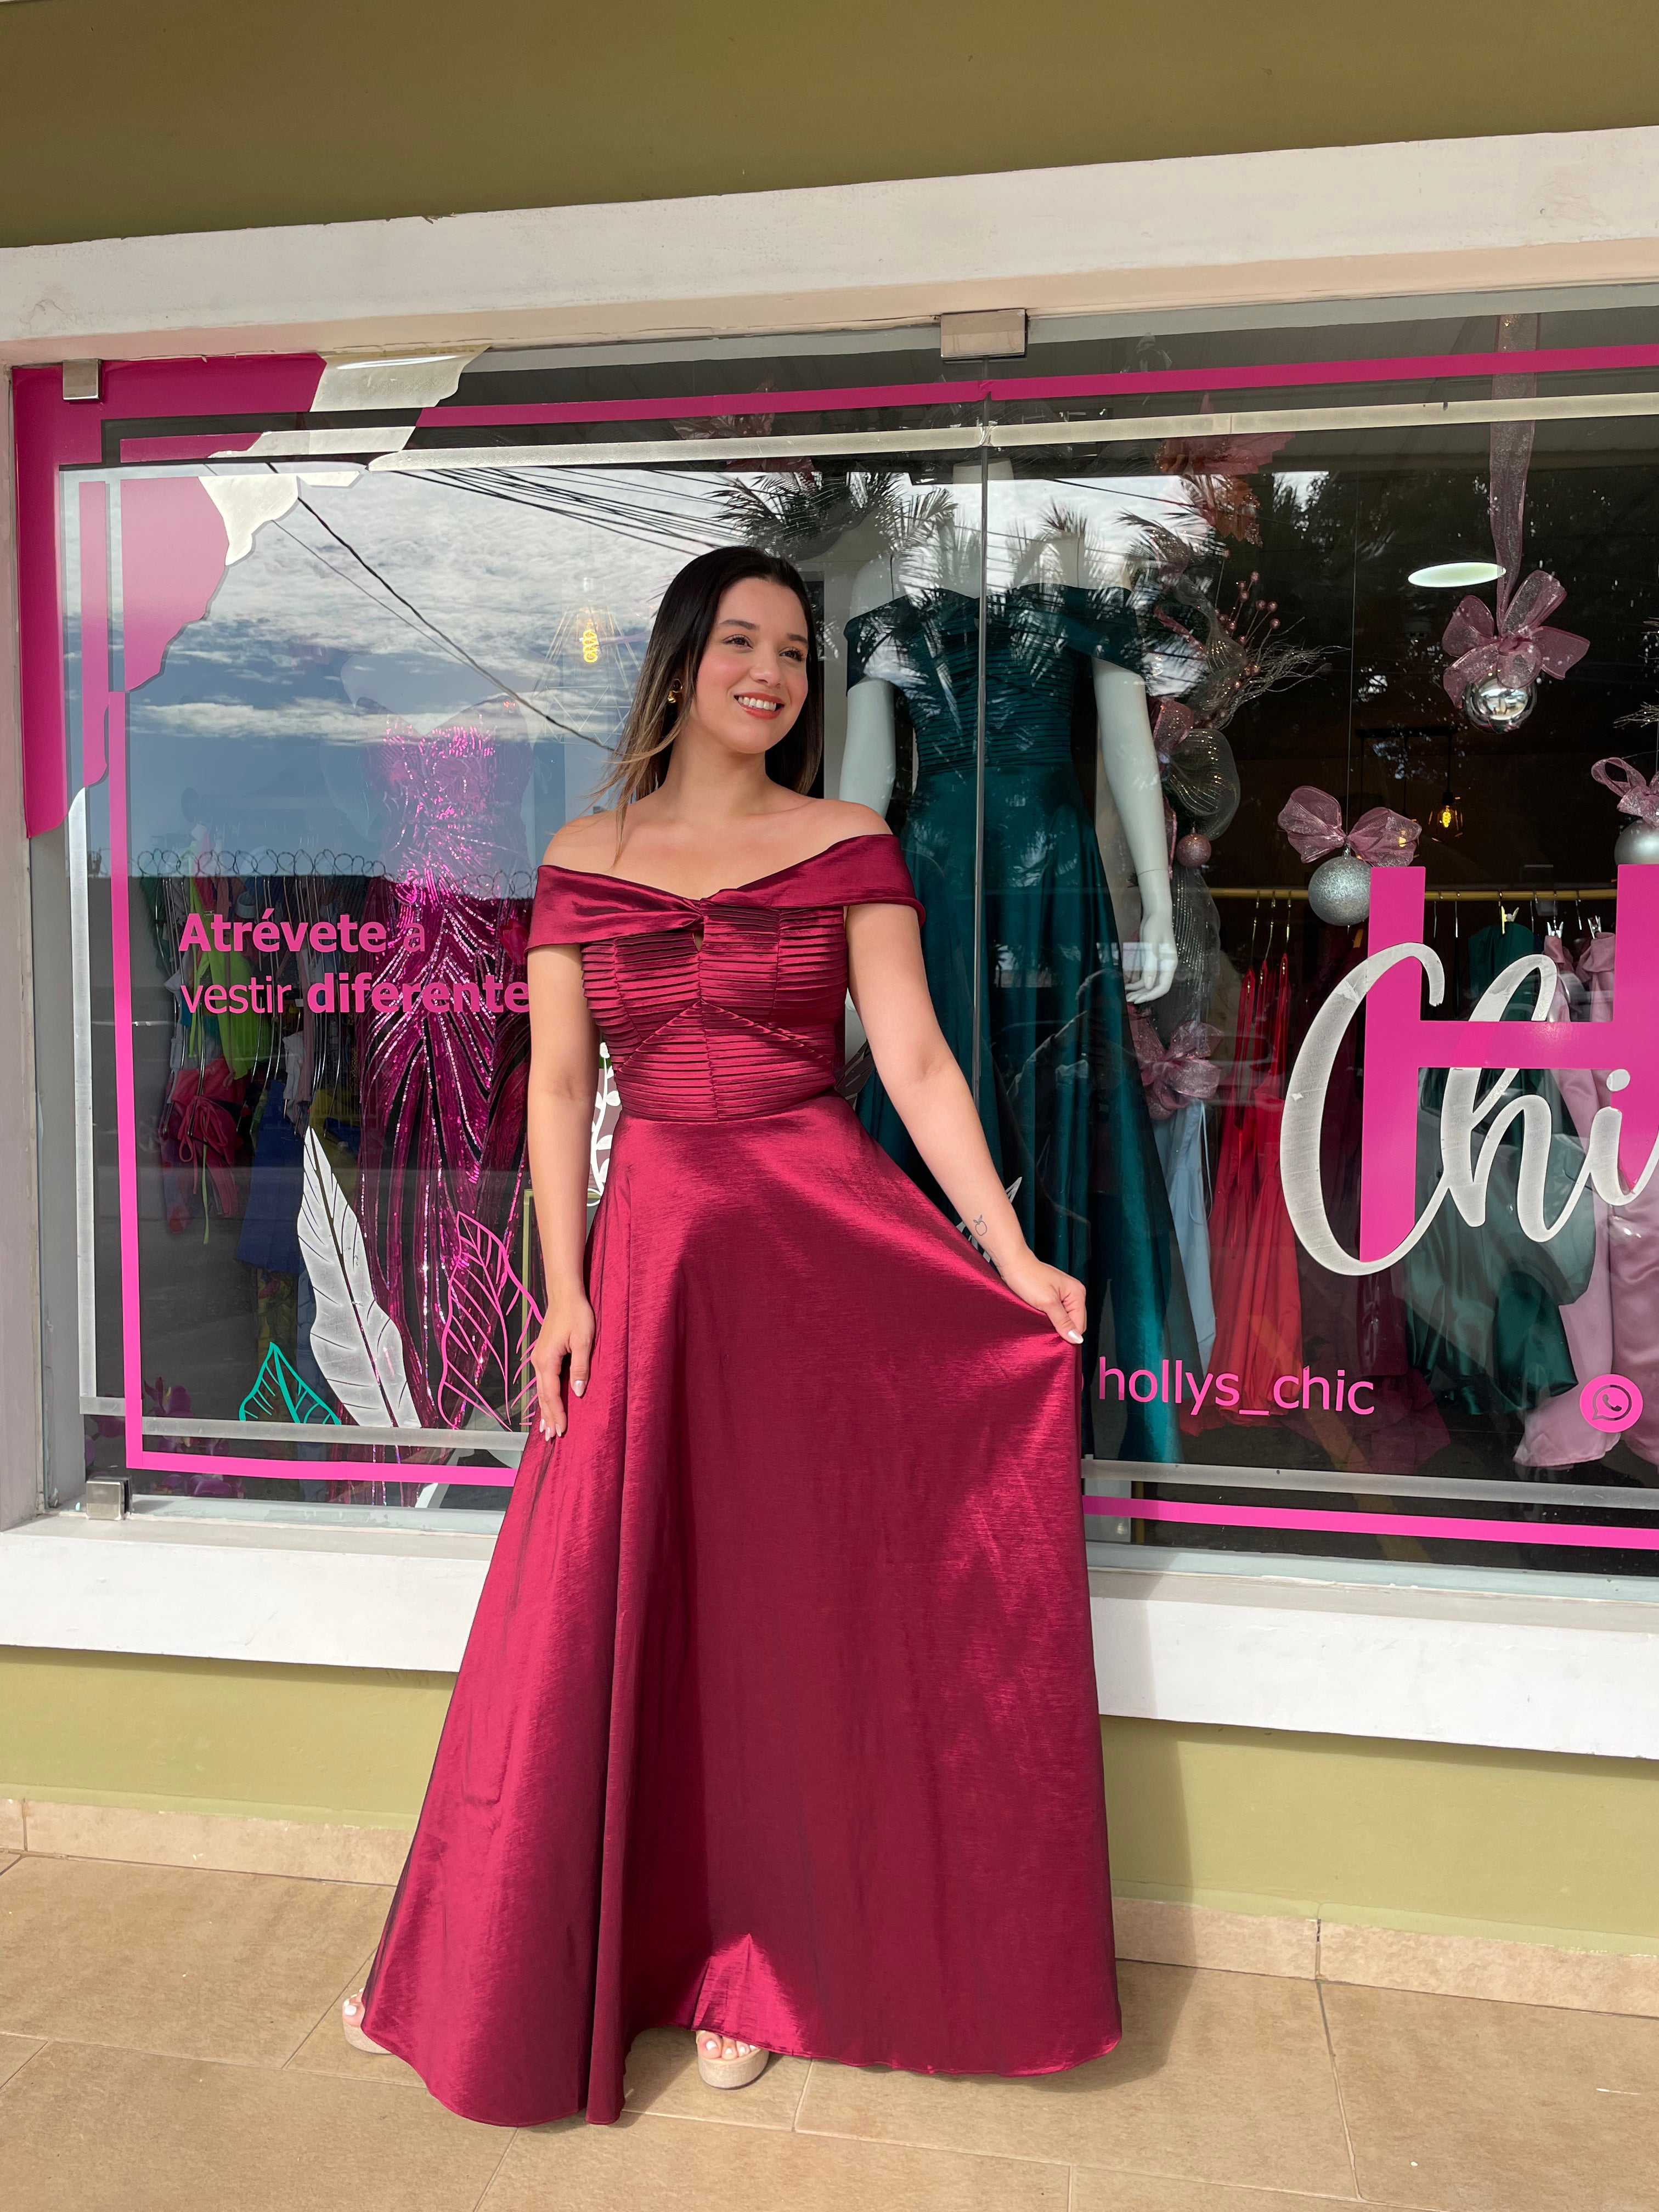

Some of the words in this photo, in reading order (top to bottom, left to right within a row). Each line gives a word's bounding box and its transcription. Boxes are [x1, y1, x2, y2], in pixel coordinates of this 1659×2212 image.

[178, 908, 387, 953] Atrévete
[403, 923, 426, 953] a
[180, 975, 292, 1014] vestir
[307, 972, 531, 1014] diferente
[1098, 1356, 1375, 1417] hollys_chic
